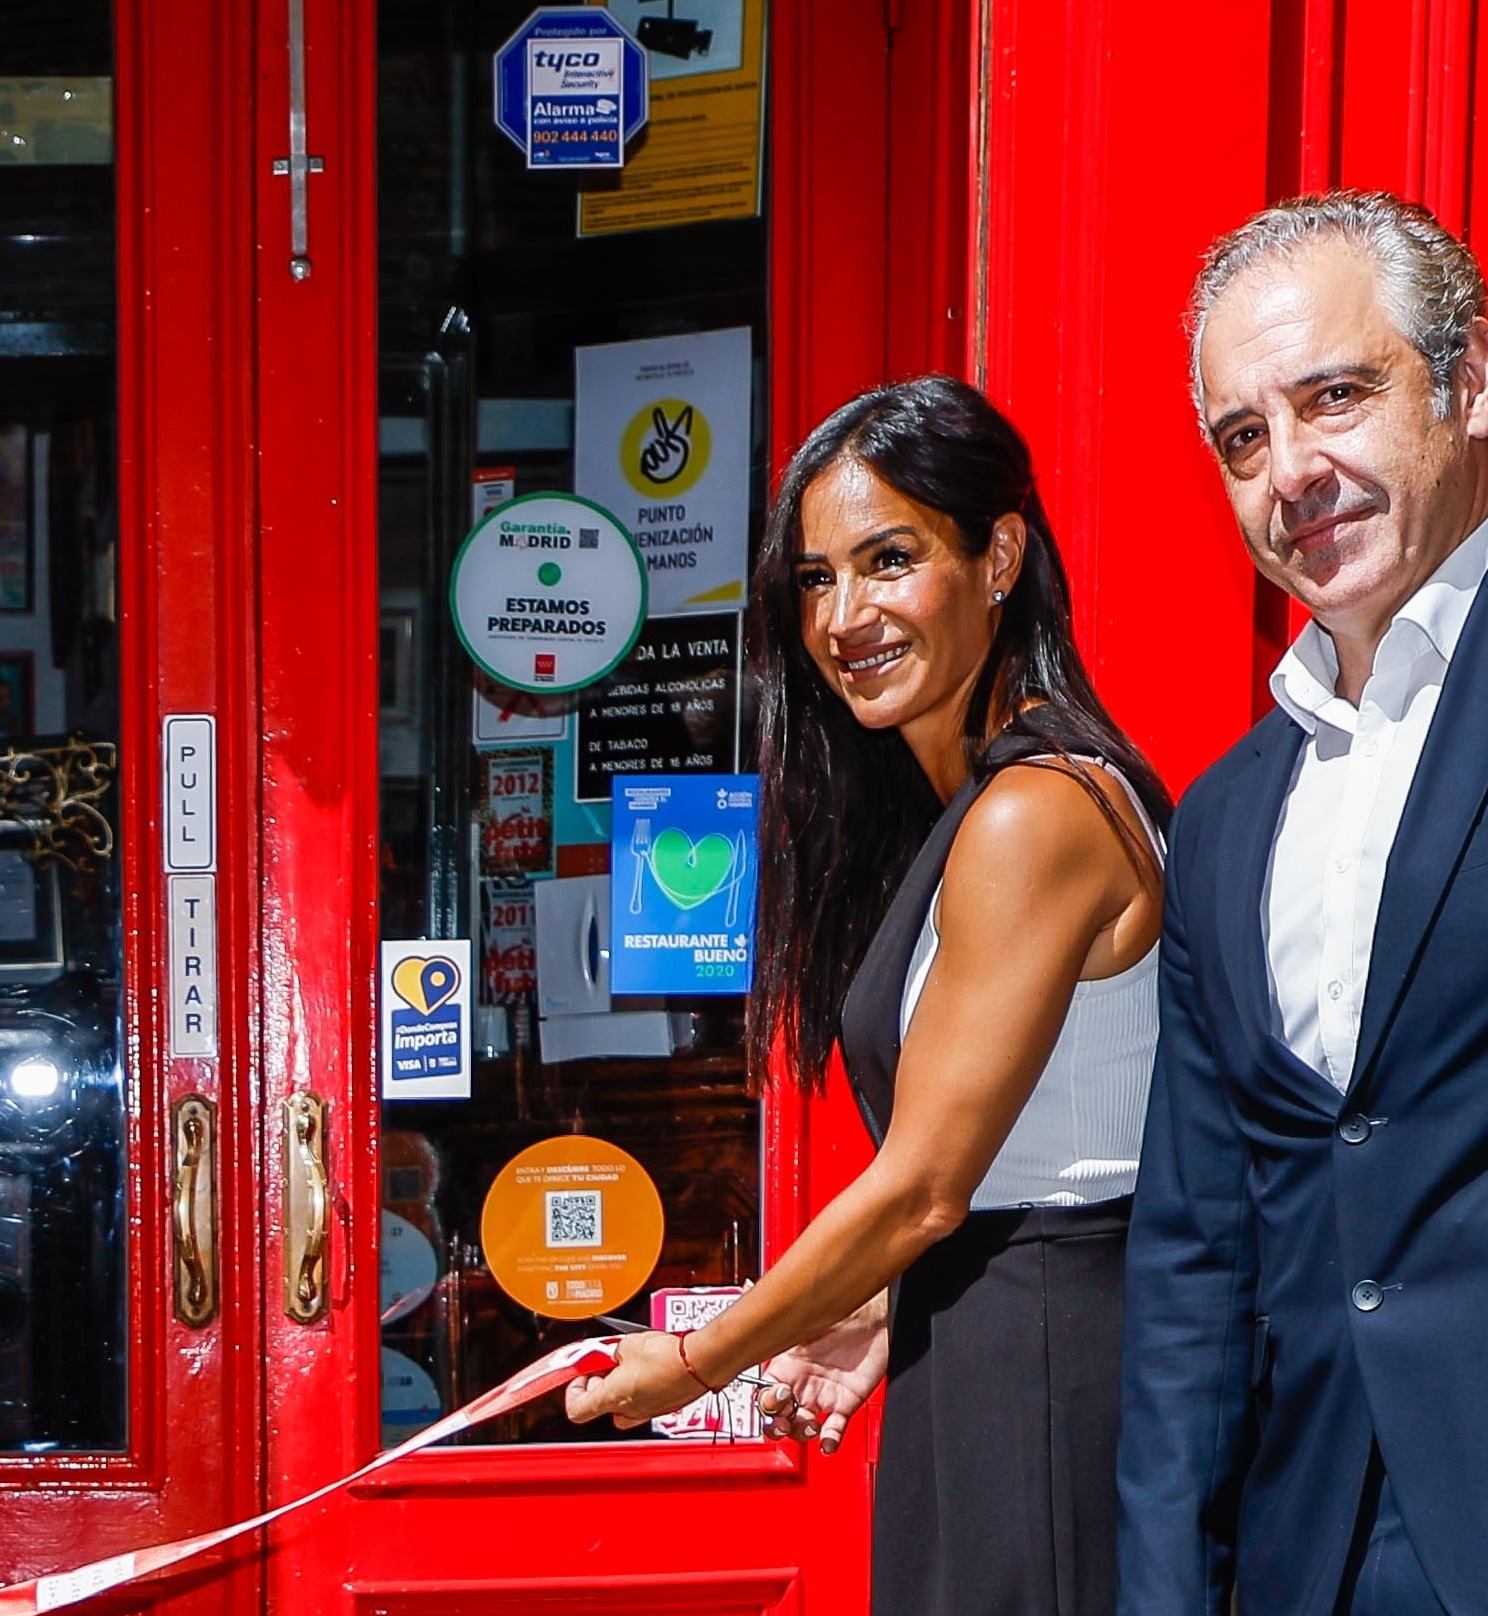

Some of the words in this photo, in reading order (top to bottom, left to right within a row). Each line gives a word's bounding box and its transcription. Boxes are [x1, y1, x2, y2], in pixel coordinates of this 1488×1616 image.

[534, 50, 600, 72] tyco
[565, 70, 614, 79] Interactive
[560, 80, 599, 89] Security
[534, 102, 595, 116] Alarma
[534, 130, 559, 144] 902
[562, 130, 588, 142] 444
[591, 129, 617, 142] 440
[638, 504, 686, 524] PUNTO
[633, 522, 714, 548] IENIZACIÓN
[647, 551, 698, 571] MANOS
[506, 598, 590, 615] ESTAMOS
[487, 617, 606, 635] PREPARADOS
[662, 643, 681, 658] LA
[688, 639, 729, 657] VENTA
[492, 772, 539, 796] 2012
[180, 746, 197, 842] PULL
[624, 934, 728, 949] RESTAURANTE
[694, 948, 747, 962] BUENO
[184, 898, 201, 1034] TIRAR
[695, 964, 735, 977] 2020
[395, 1031, 457, 1051] Importa
[396, 1059, 421, 1071] VISA
